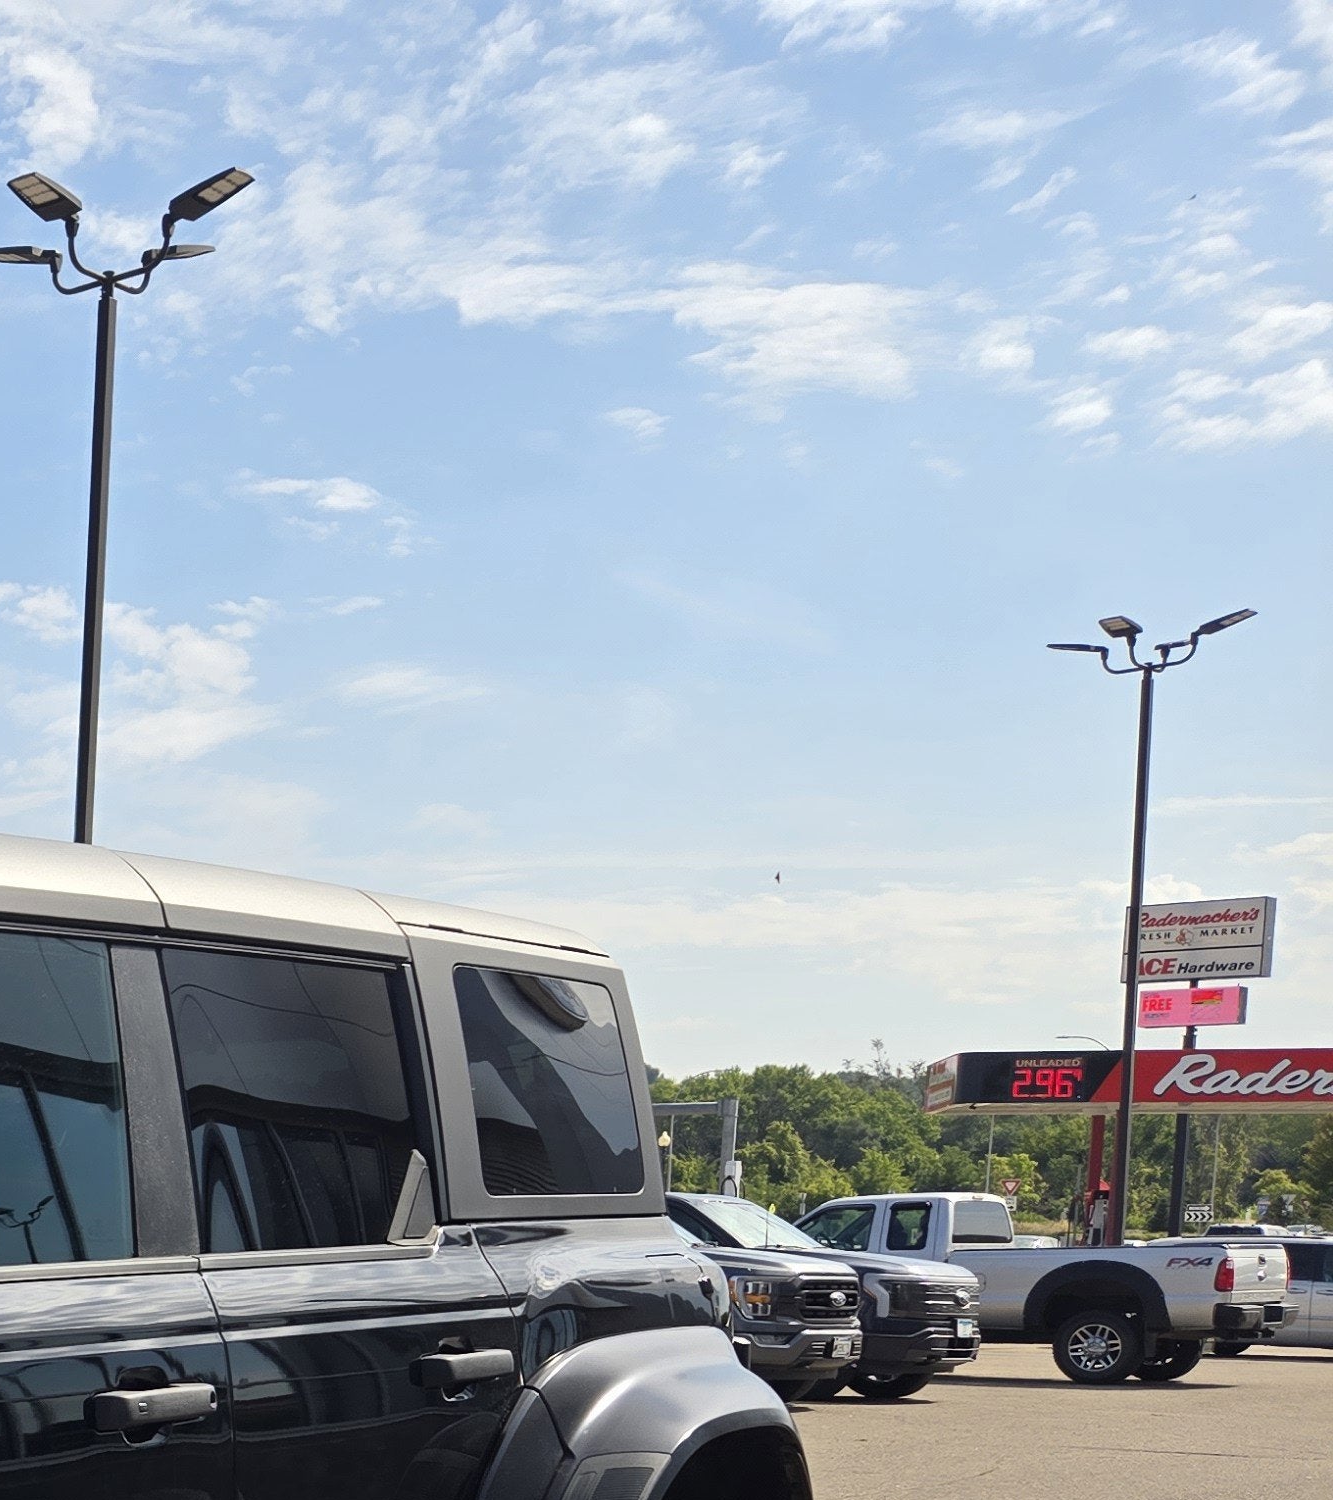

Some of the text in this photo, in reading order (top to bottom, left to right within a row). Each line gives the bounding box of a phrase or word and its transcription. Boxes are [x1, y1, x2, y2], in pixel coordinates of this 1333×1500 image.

[1140, 926, 1255, 941] RESH MARKET
[1177, 960, 1255, 975] Hardware
[1141, 997, 1173, 1012] FREE
[1016, 1057, 1081, 1068] UNLEADED
[1166, 1256, 1214, 1268] FX4
